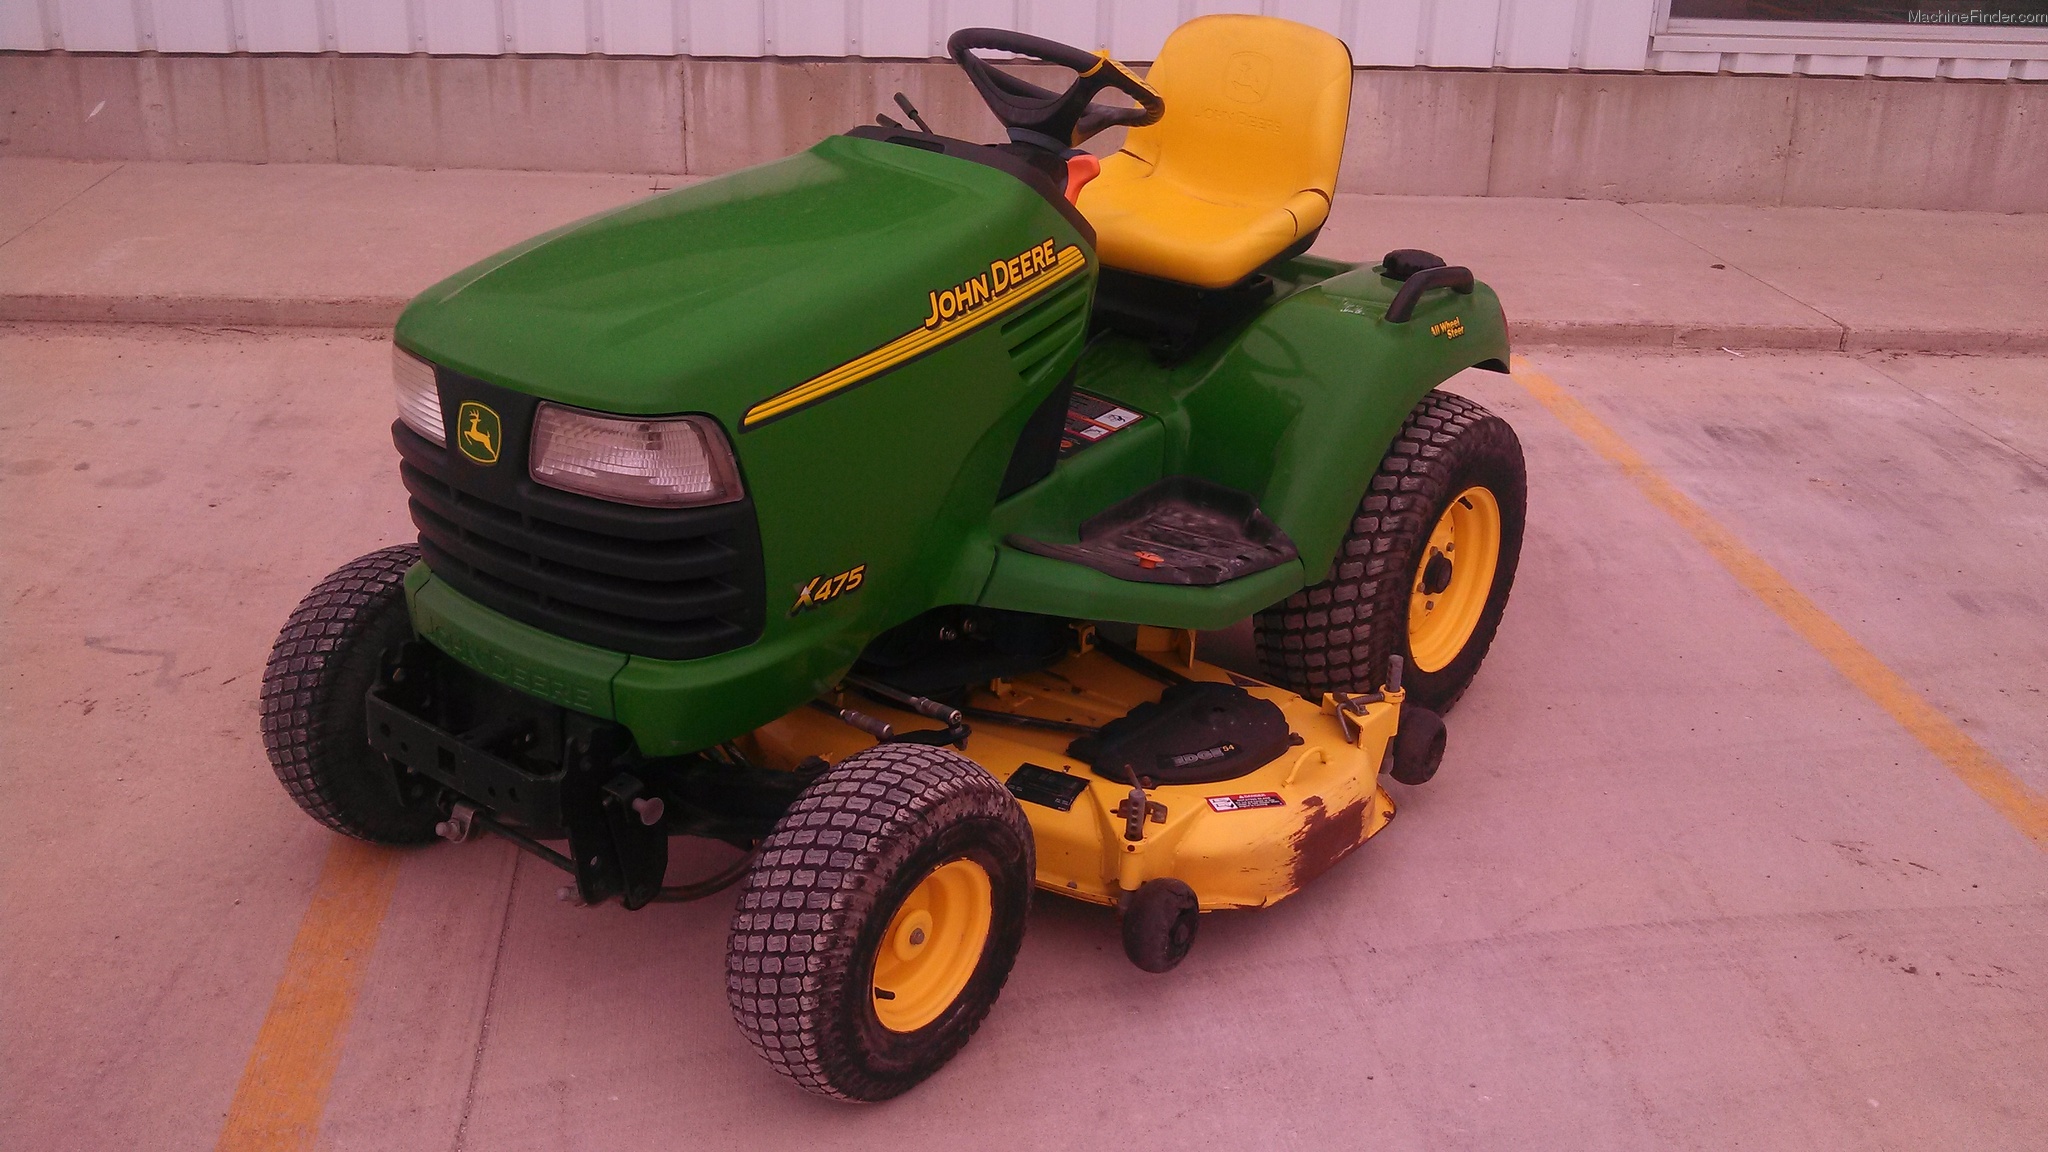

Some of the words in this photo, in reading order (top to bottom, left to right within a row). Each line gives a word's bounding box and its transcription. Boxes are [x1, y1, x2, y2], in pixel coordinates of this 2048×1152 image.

[924, 272, 990, 329] JOHN
[990, 238, 1057, 295] DEERE
[1439, 316, 1461, 333] Wheel
[1446, 326, 1465, 340] Steer
[788, 564, 866, 616] X475
[490, 654, 595, 710] DEERE
